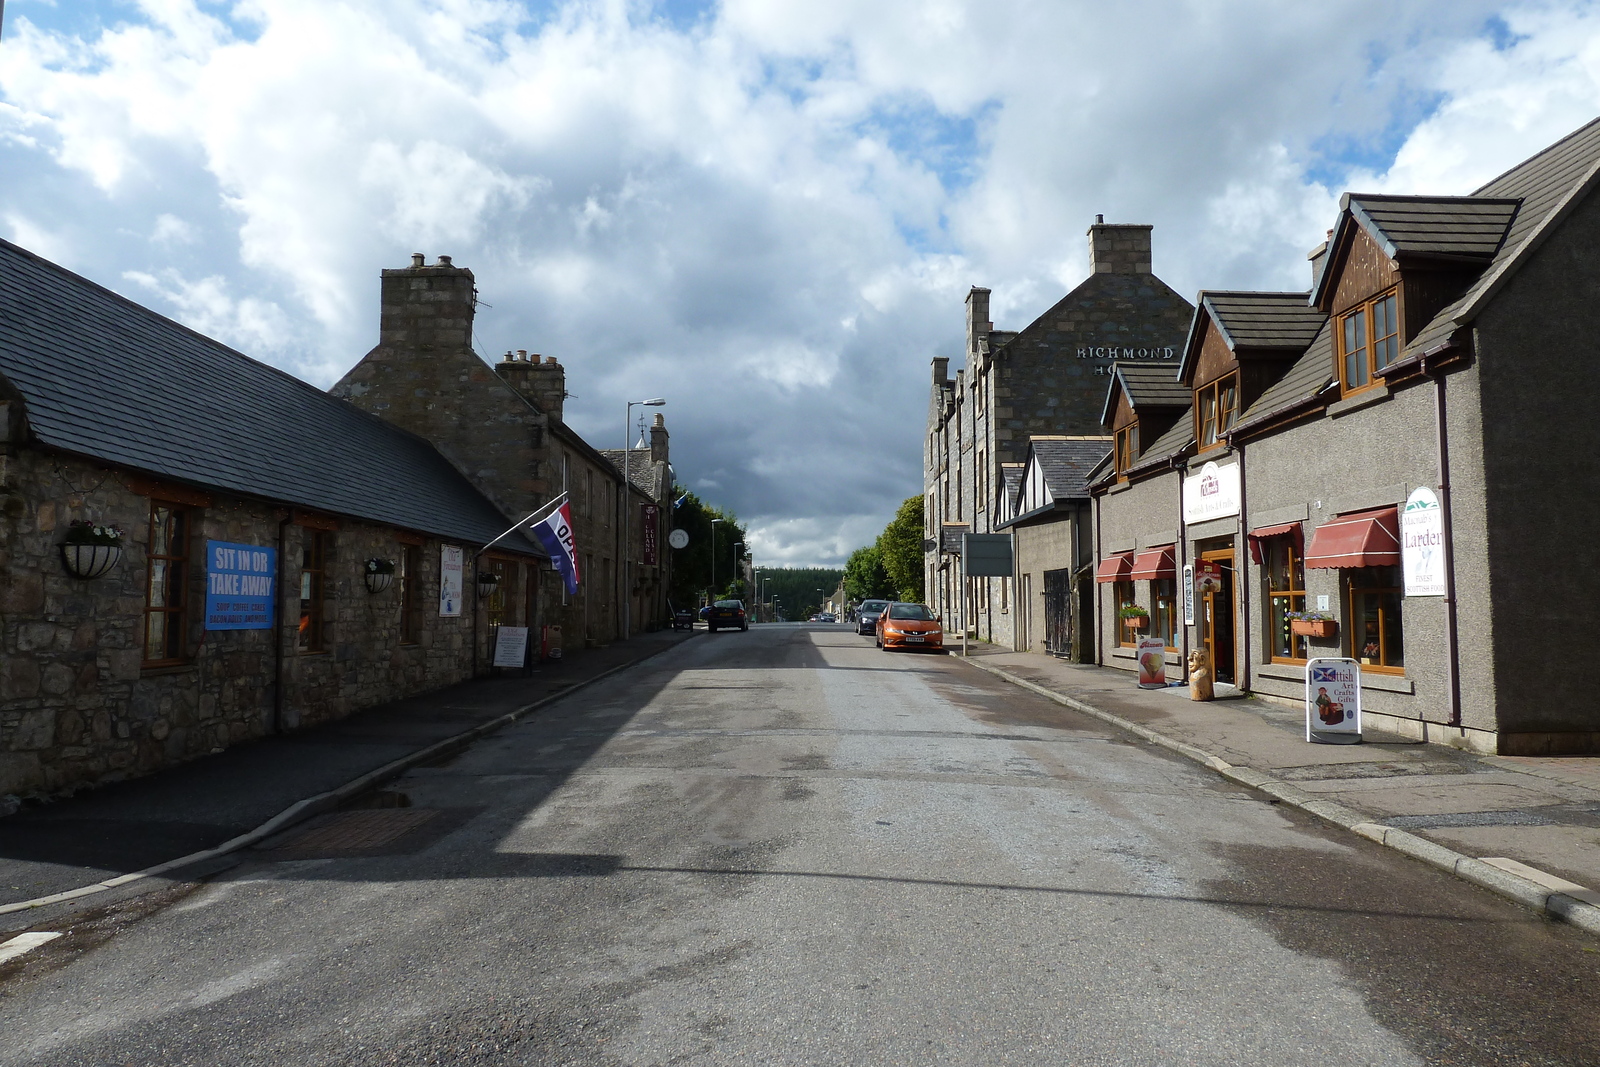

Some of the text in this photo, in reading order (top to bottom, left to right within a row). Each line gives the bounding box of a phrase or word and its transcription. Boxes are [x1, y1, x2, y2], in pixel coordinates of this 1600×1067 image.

[1076, 346, 1174, 359] RICHMOND
[1404, 512, 1432, 526] Macnab's
[1405, 529, 1442, 549] Larder
[215, 547, 268, 573] SIT IN OR
[209, 573, 272, 597] TAKE AWAY
[1415, 575, 1433, 583] FINEST
[1406, 584, 1445, 593] SCOTTISH FOOD
[216, 602, 266, 612] SOUP COFFEE CAKES
[209, 614, 227, 624] BACON
[1322, 669, 1354, 683] Scottish
